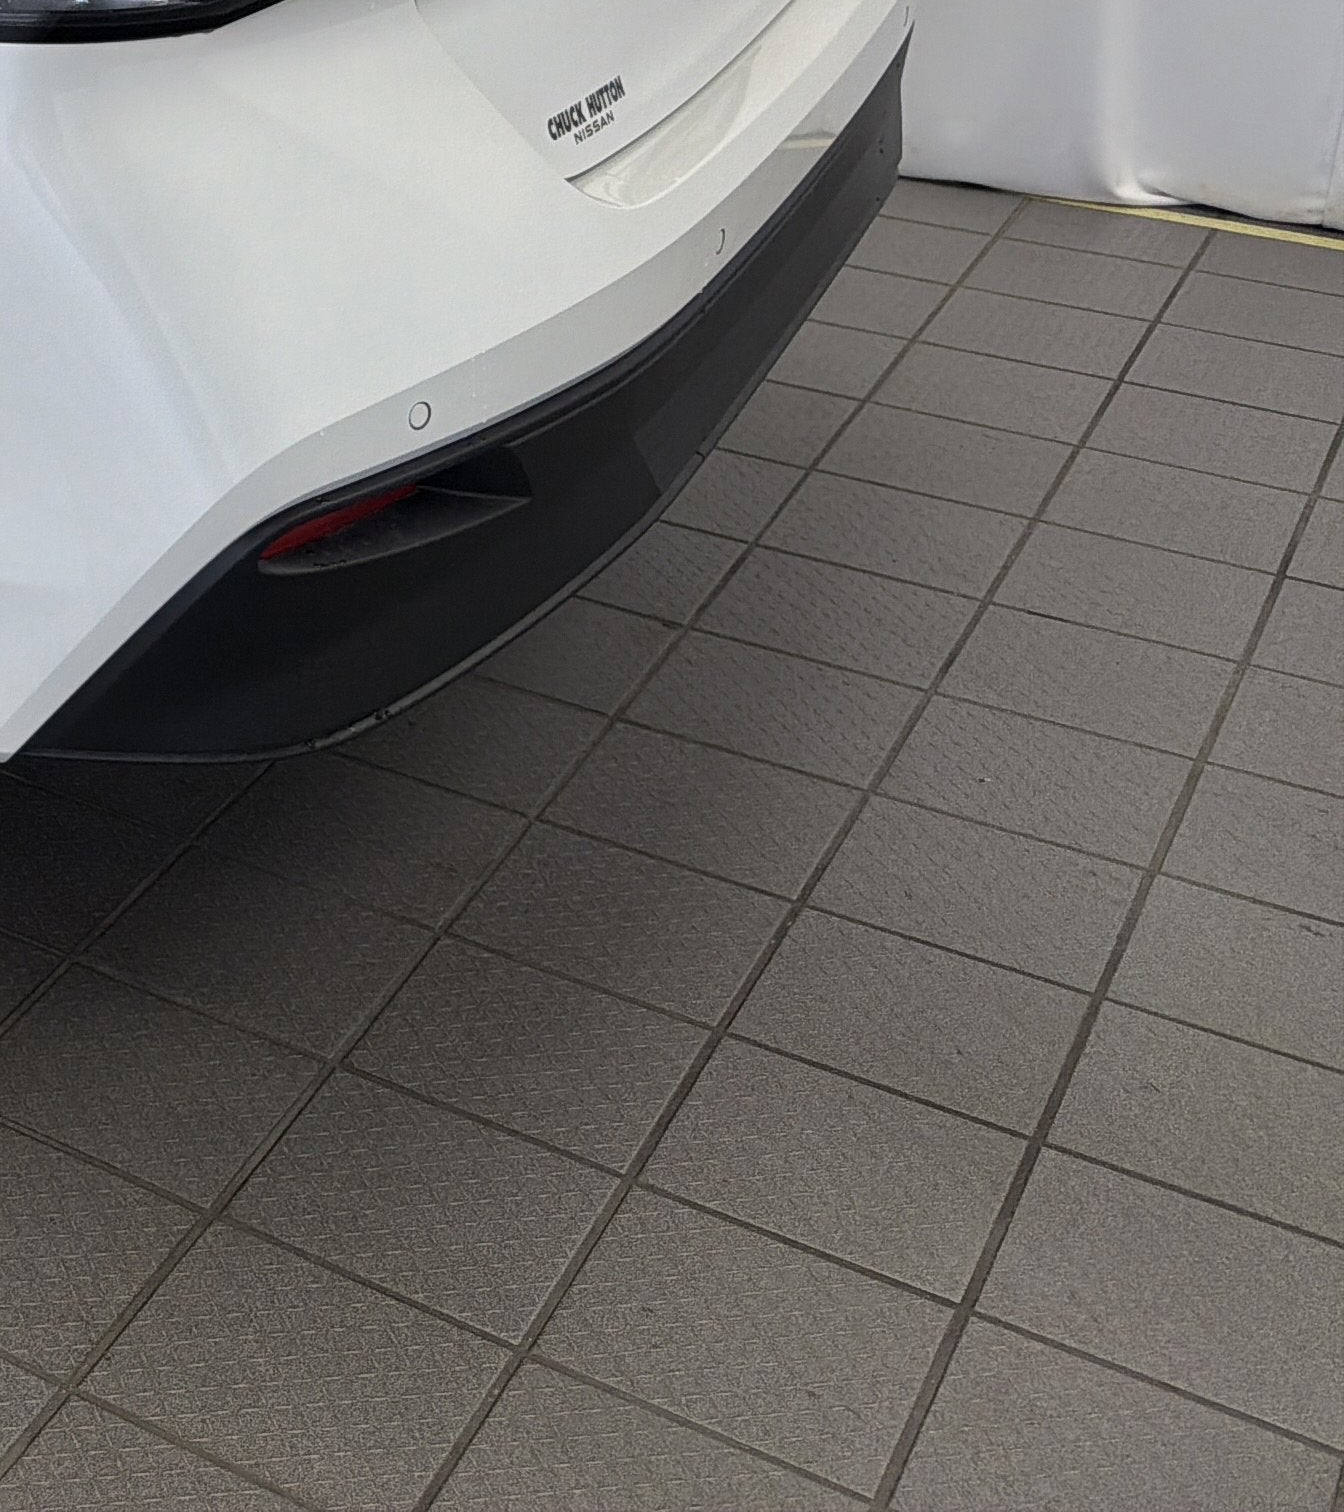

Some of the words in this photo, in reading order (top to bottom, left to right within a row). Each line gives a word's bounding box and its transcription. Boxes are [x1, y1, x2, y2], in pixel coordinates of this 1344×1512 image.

[548, 100, 587, 141] CHUCK
[585, 75, 626, 119] HUTTON
[573, 109, 615, 145] NISSAN
